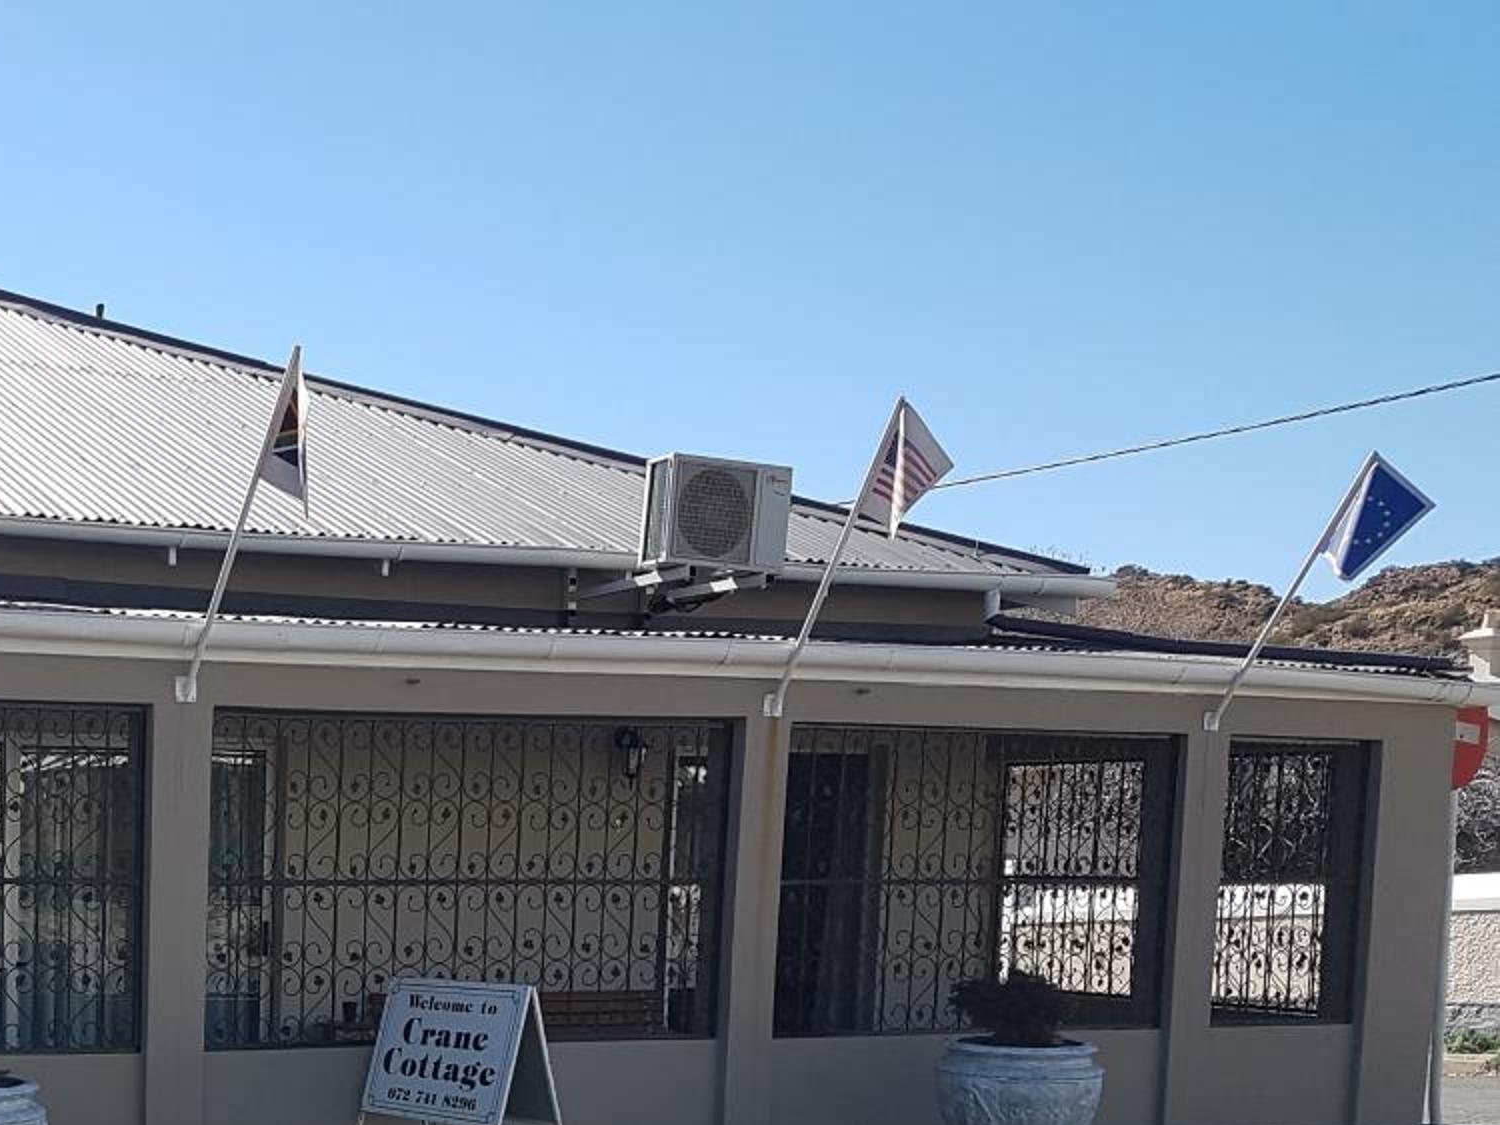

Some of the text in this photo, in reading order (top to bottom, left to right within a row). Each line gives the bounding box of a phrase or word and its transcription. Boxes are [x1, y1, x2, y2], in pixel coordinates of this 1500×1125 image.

[409, 994, 498, 1015] Welcome to
[403, 1017, 489, 1051] Crane
[383, 1047, 496, 1092] Cottage
[387, 1087, 411, 1101] 072
